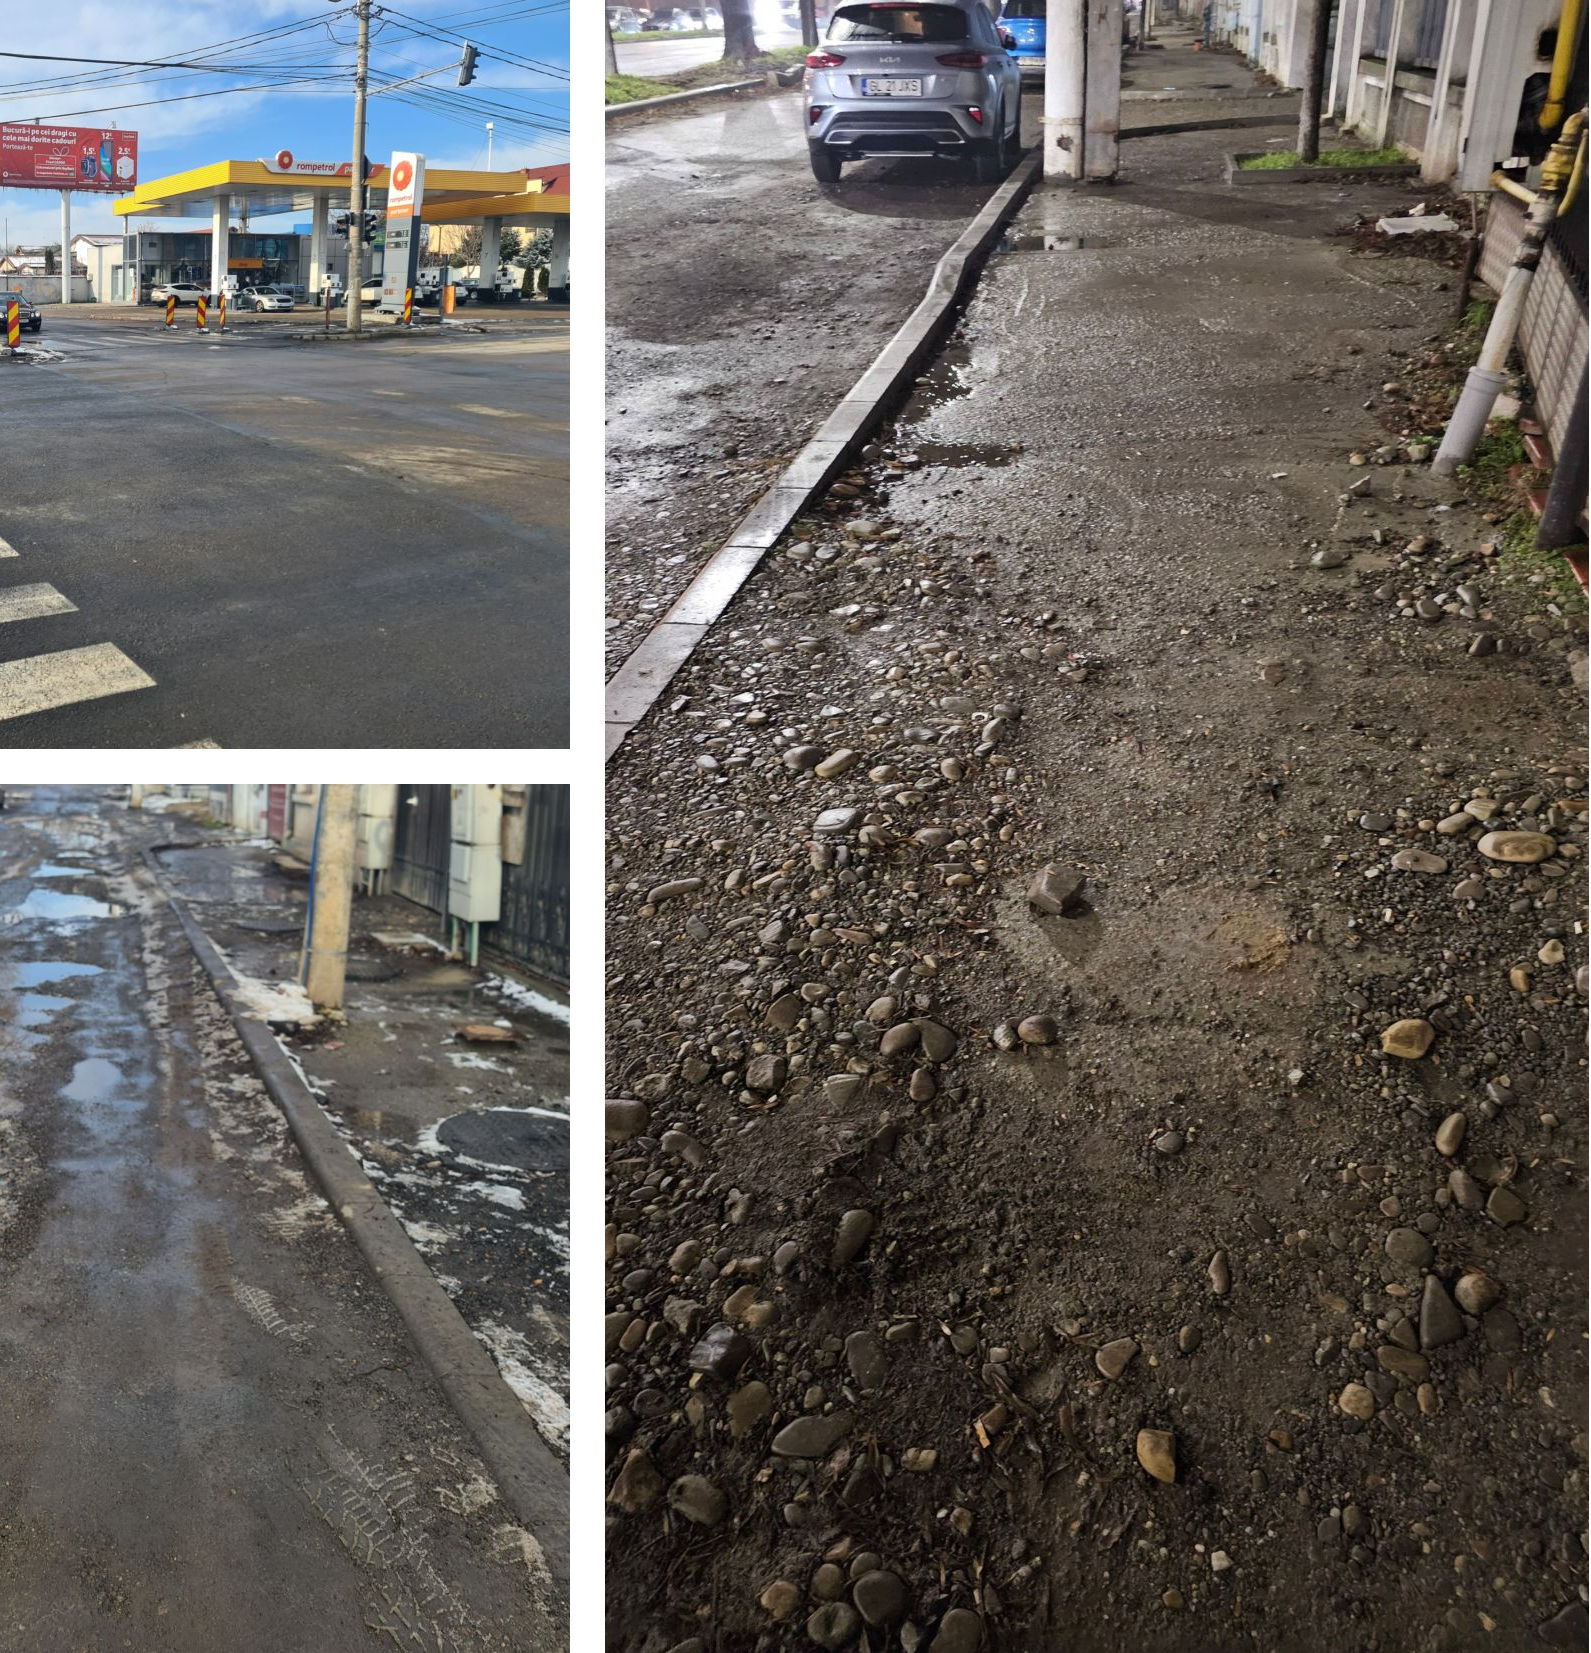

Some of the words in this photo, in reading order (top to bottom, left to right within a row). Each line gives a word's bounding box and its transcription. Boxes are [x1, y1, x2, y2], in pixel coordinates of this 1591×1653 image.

[3, 126, 30, 134] Bucură-i
[3, 143, 33, 151] Portează-te
[297, 163, 336, 172] rompetrol
[390, 193, 413, 203] rompetrol
